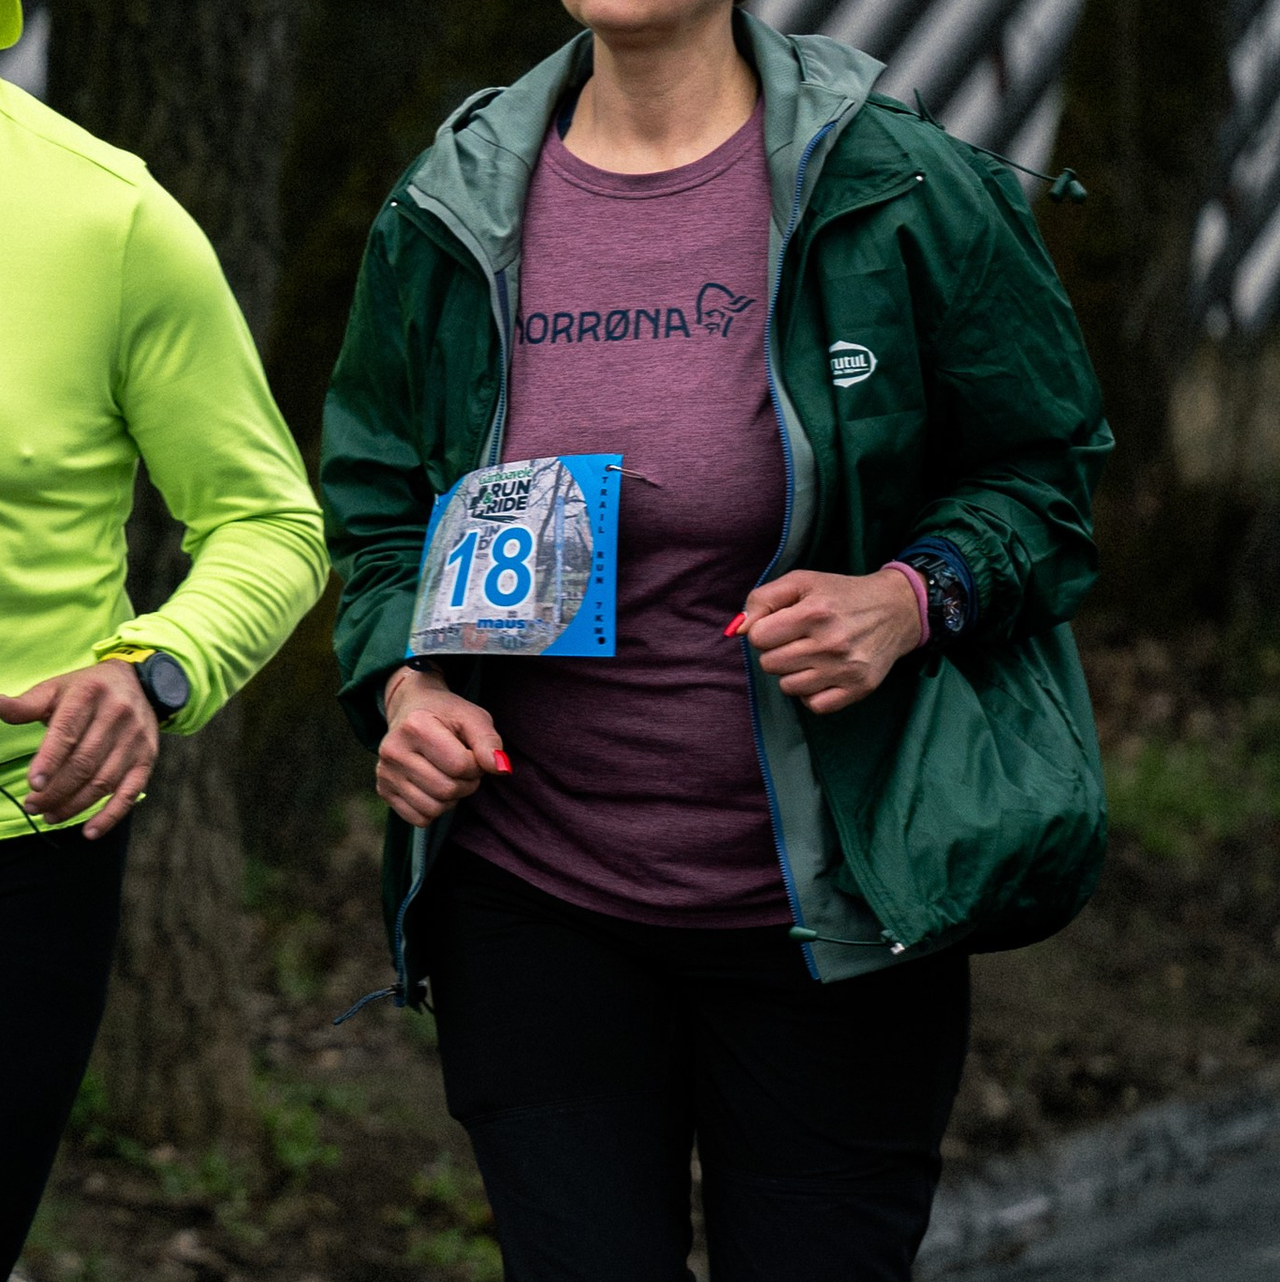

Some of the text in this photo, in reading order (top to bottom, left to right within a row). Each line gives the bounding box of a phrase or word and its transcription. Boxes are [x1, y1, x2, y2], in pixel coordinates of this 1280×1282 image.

[492, 479, 532, 498] RUN
[485, 496, 528, 515] RIDE
[599, 476, 609, 534] TRAIL
[447, 525, 534, 609] 18
[596, 551, 605, 585] RUN
[476, 618, 526, 630] maus
